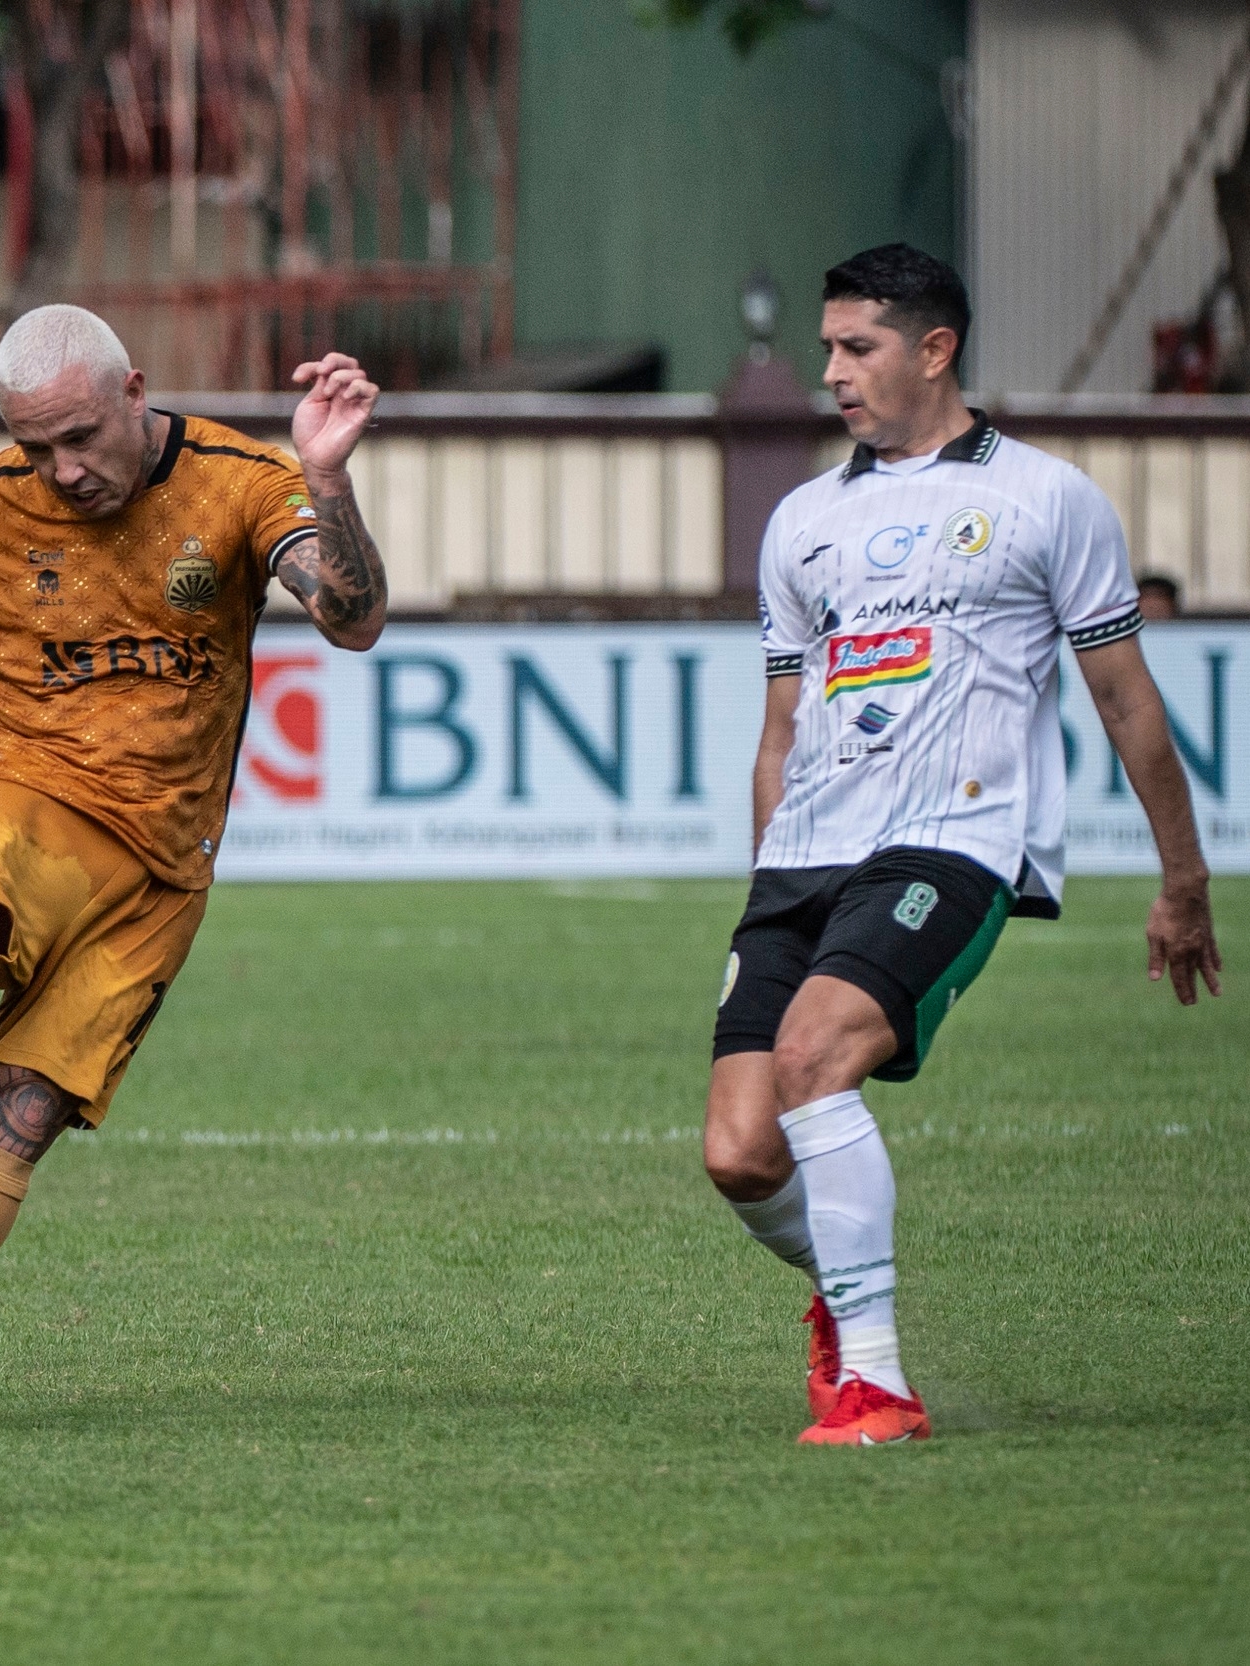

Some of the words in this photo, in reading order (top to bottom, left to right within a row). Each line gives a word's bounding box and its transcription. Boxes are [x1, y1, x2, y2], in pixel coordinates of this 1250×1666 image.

[851, 595, 960, 622] AMMAN
[107, 634, 214, 680] BNI
[368, 648, 707, 804] BNI
[893, 881, 939, 930] 8
